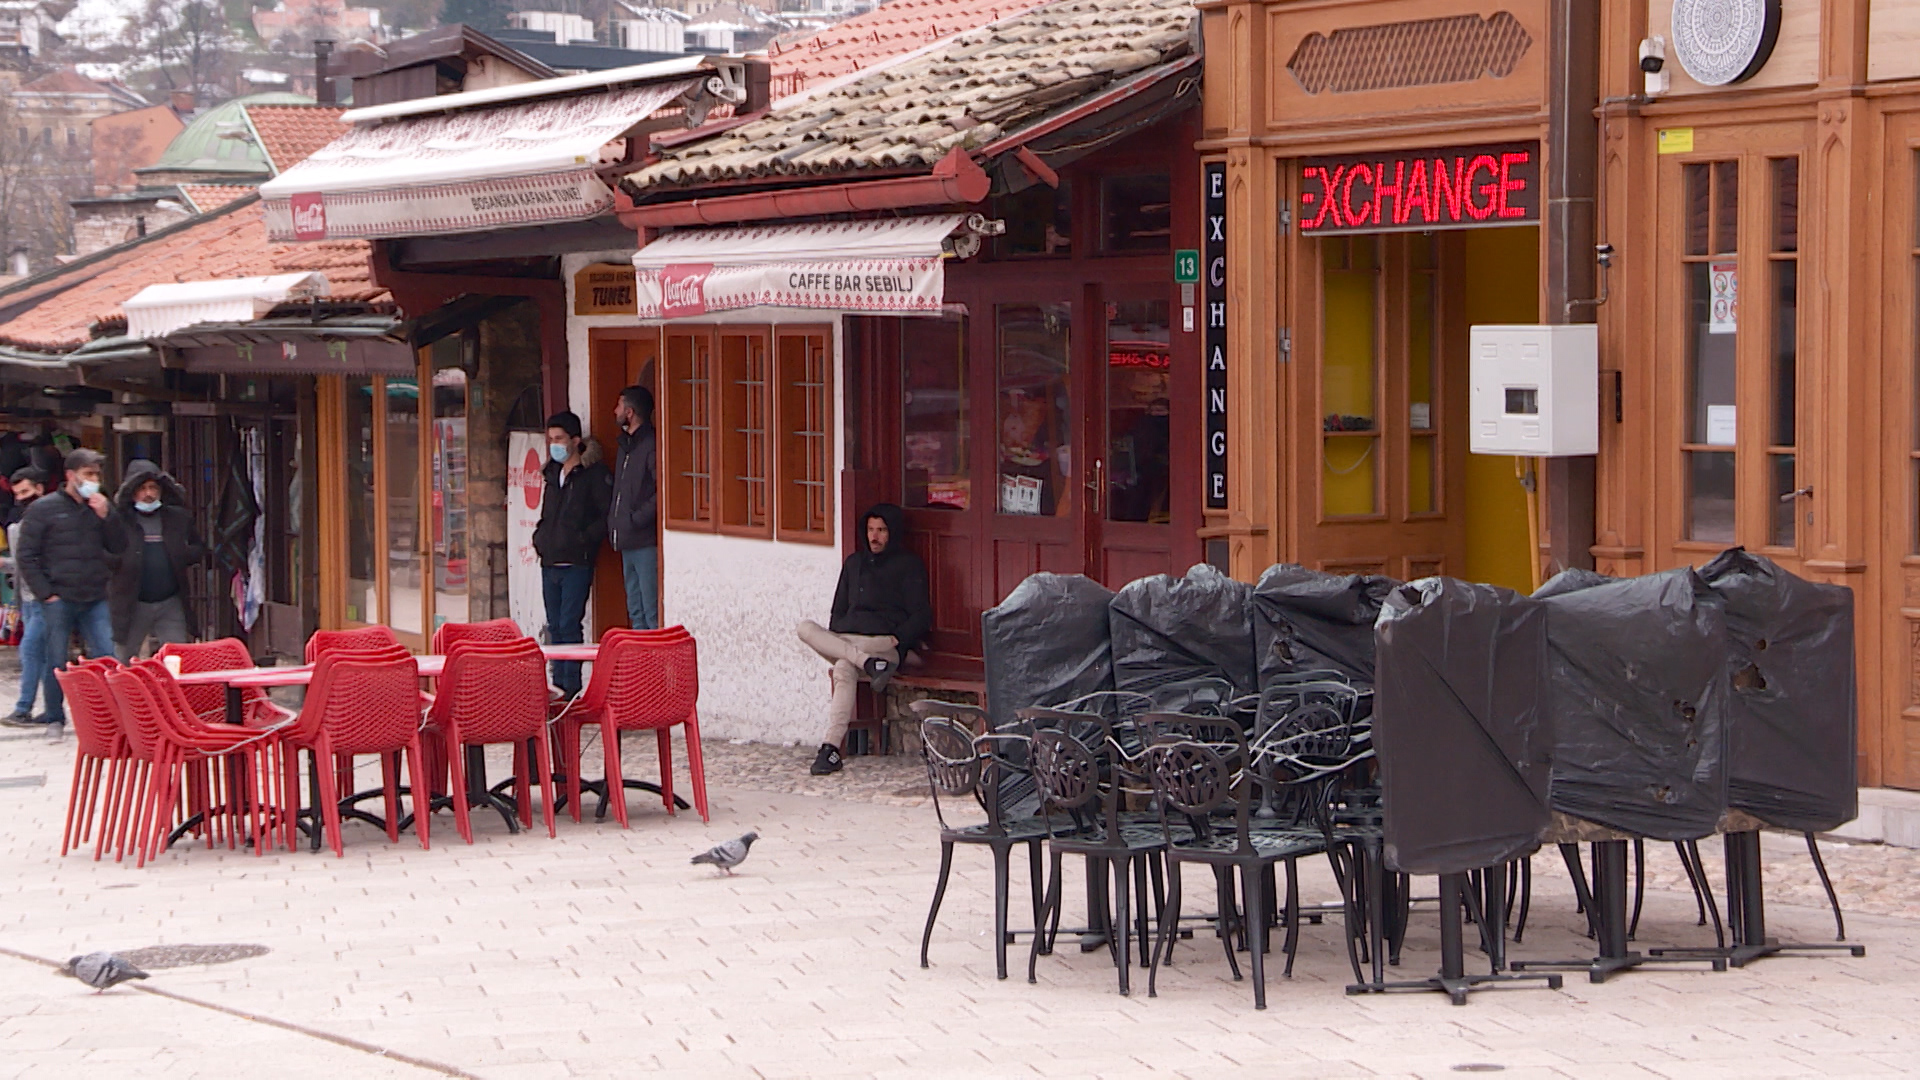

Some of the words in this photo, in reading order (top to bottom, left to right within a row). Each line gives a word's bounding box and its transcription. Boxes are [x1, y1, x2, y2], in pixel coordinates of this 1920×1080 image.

[1300, 152, 1529, 229] EXCHANGE
[1179, 256, 1195, 276] 13
[789, 272, 831, 291] CAFFE
[834, 274, 861, 292] BAR
[865, 275, 913, 293] SEBILJ
[592, 285, 633, 307] TUNEL
[1210, 172, 1226, 499] EXCHANGE
